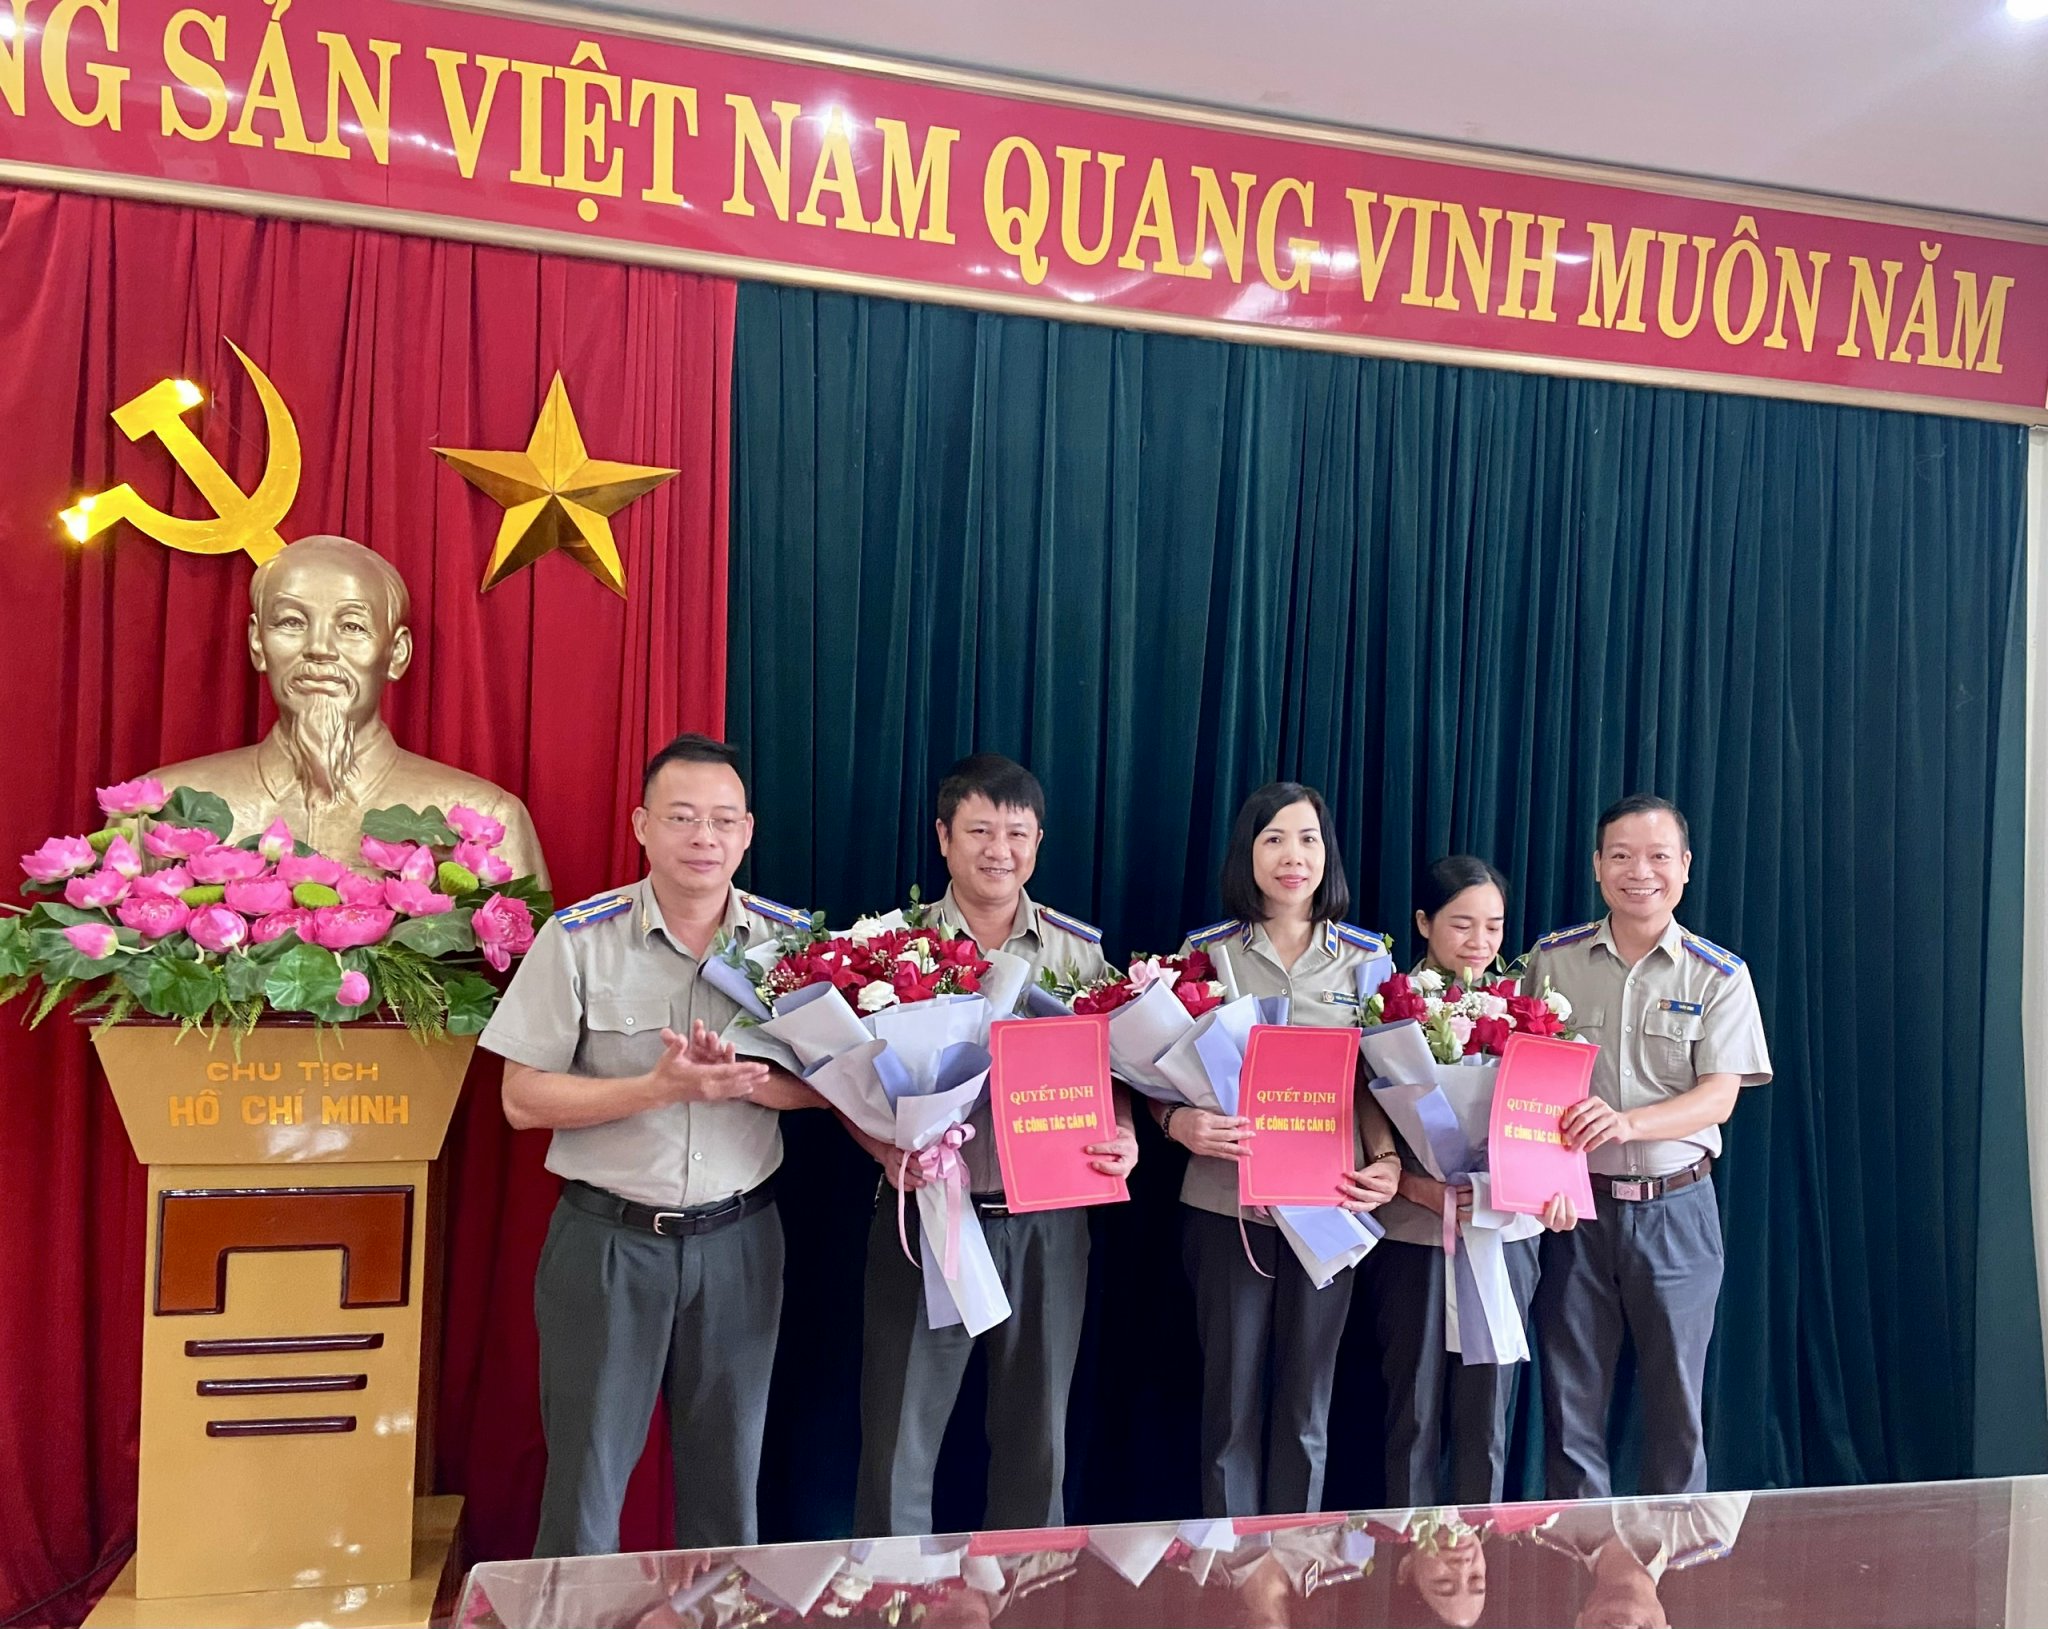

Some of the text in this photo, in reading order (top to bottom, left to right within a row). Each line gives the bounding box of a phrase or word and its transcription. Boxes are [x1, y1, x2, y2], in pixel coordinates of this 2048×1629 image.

[161, 0, 401, 165] SẢN
[426, 40, 698, 222] VIỆT
[723, 94, 960, 245] NAM
[984, 136, 1320, 294] QUANG
[1346, 188, 1565, 323] VINH
[1579, 215, 1831, 352] MUÔN
[1838, 241, 2014, 374] NĂM
[297, 1061, 379, 1087] TỊCH
[1010, 1084, 1094, 1105] QUYẾT ĐỊNH
[1257, 1086, 1336, 1106] QUYẾT ĐỊNH
[168, 1088, 409, 1127] HỒ CHÍ MINH
[1507, 1097, 1567, 1118] QUYẾT ĐỊN
[1025, 1116, 1049, 1132] CÔNG
[1049, 1114, 1066, 1130] TÁC
[1066, 1112, 1085, 1129] CÁN
[1267, 1115, 1289, 1131] CÔNG
[1290, 1116, 1306, 1131] TÁC
[1307, 1116, 1324, 1132] CÁN
[1325, 1117, 1336, 1134] BỘ
